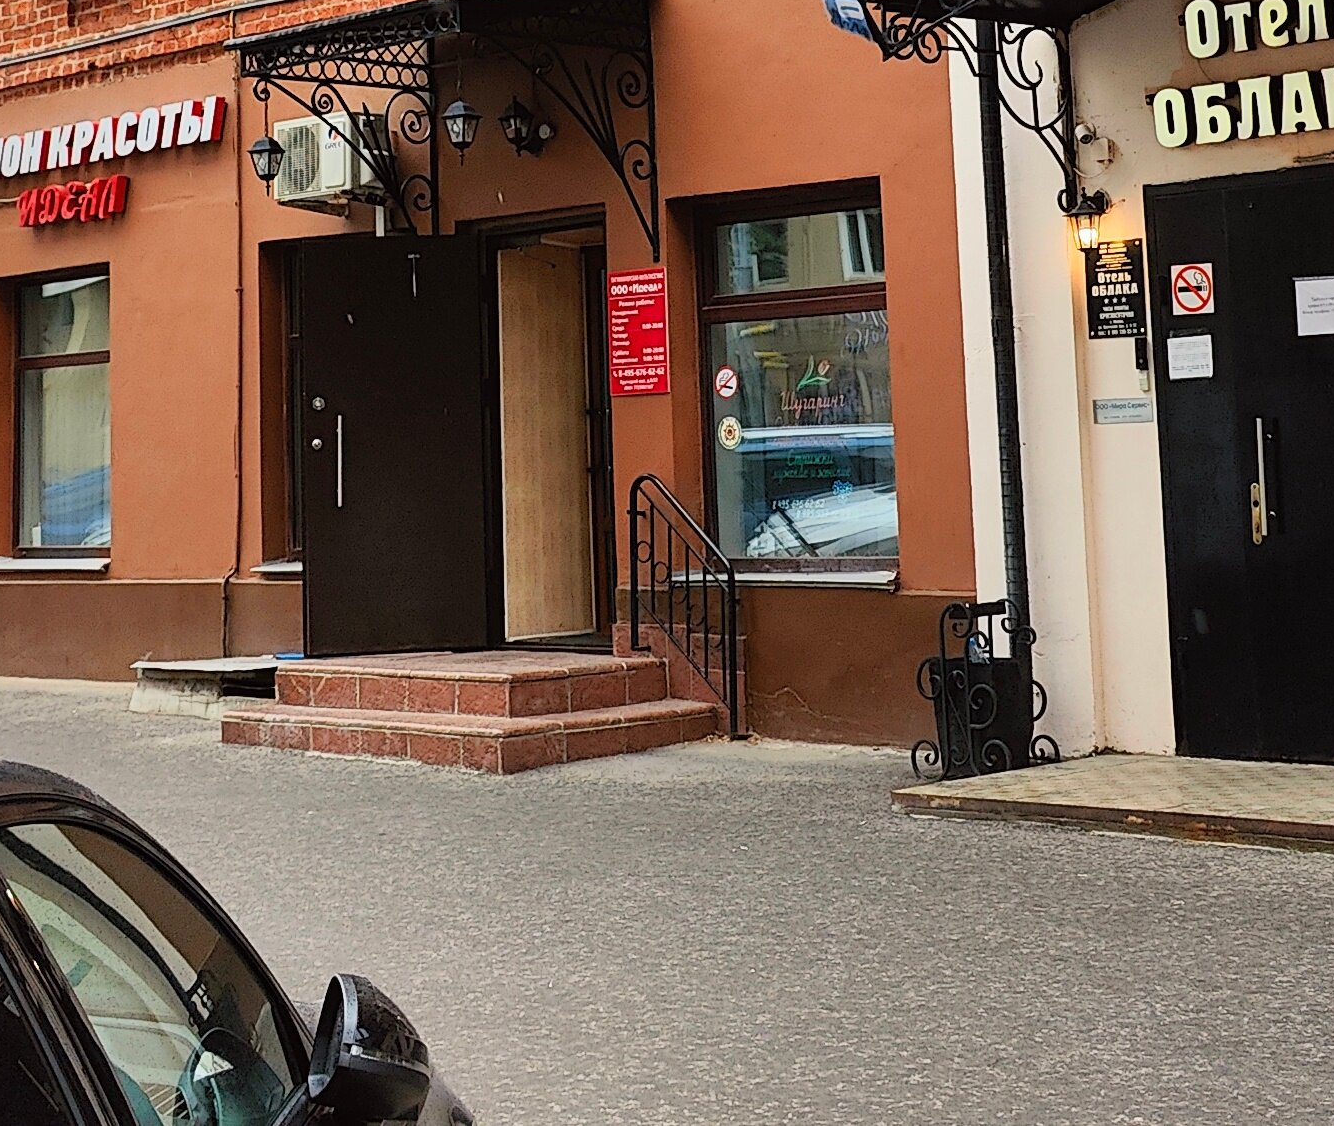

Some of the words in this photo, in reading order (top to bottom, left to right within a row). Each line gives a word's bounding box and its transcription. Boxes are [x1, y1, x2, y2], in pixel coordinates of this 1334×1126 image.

[45, 96, 224, 170] КРАСОТЫ
[16, 175, 130, 228] ИДЕАЛ
[1097, 272, 1132, 284] Отель
[610, 284, 628, 295] ООО
[1091, 282, 1139, 297] ОБЛАКА
